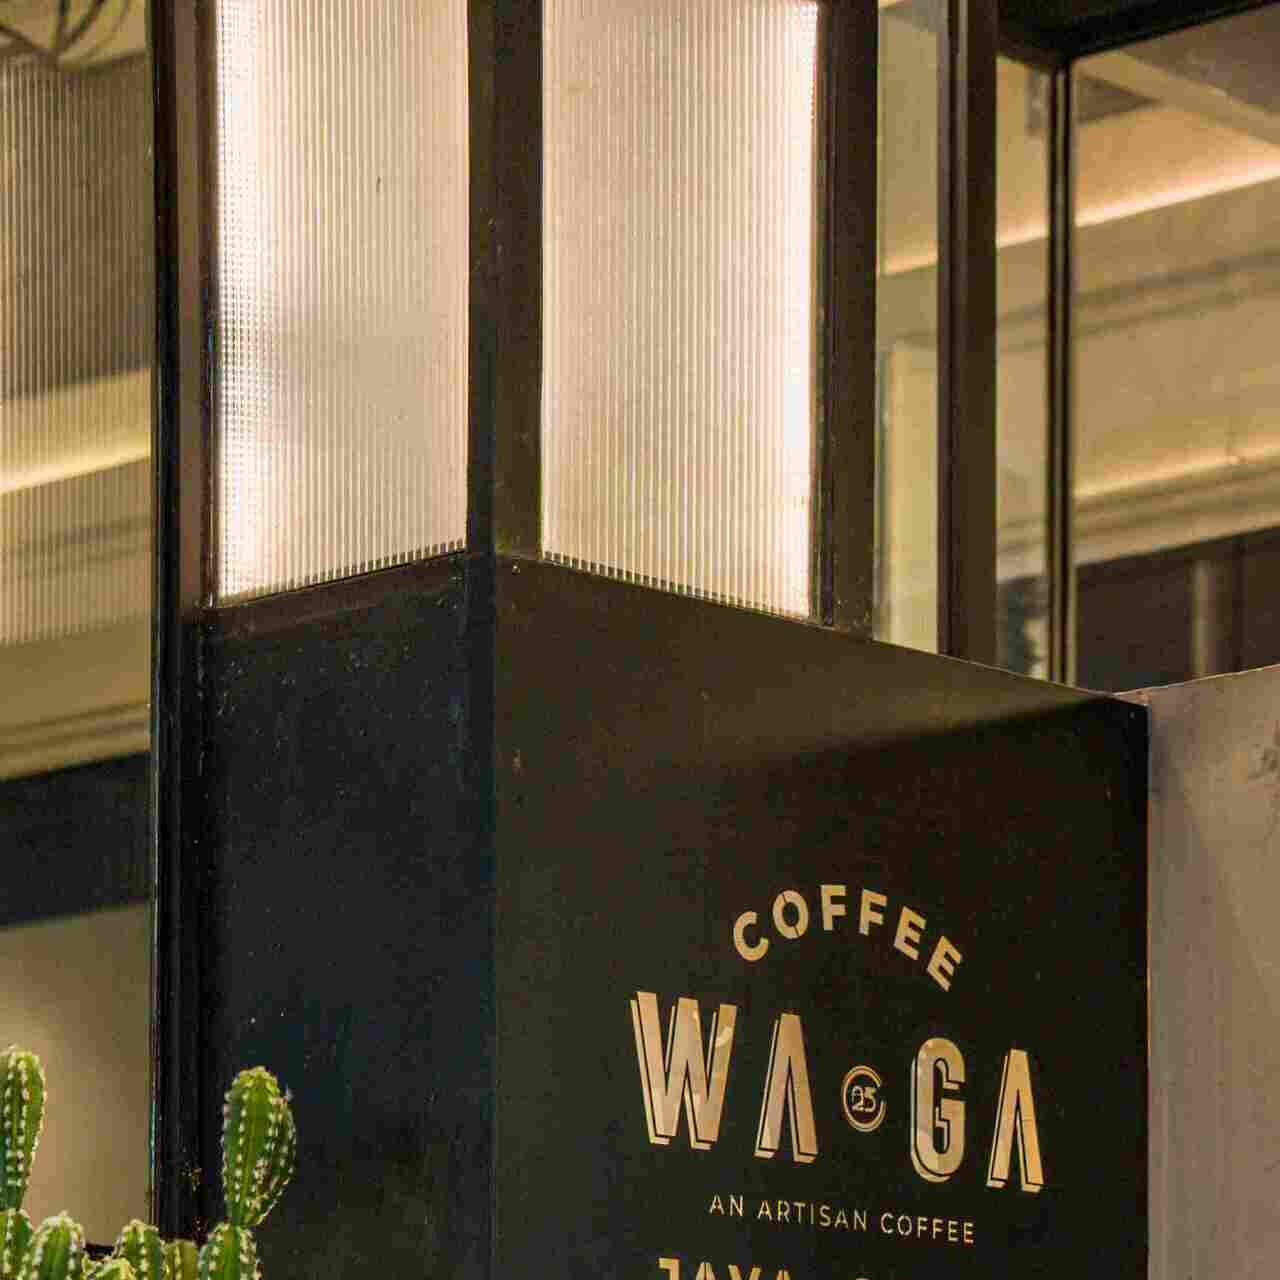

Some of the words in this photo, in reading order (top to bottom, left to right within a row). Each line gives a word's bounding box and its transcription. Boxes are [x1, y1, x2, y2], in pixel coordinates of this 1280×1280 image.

[733, 885, 962, 991] COFFEE
[709, 1195, 743, 1216] AN
[757, 1200, 866, 1230] ARTISAN
[881, 1213, 973, 1243] COFFEE
